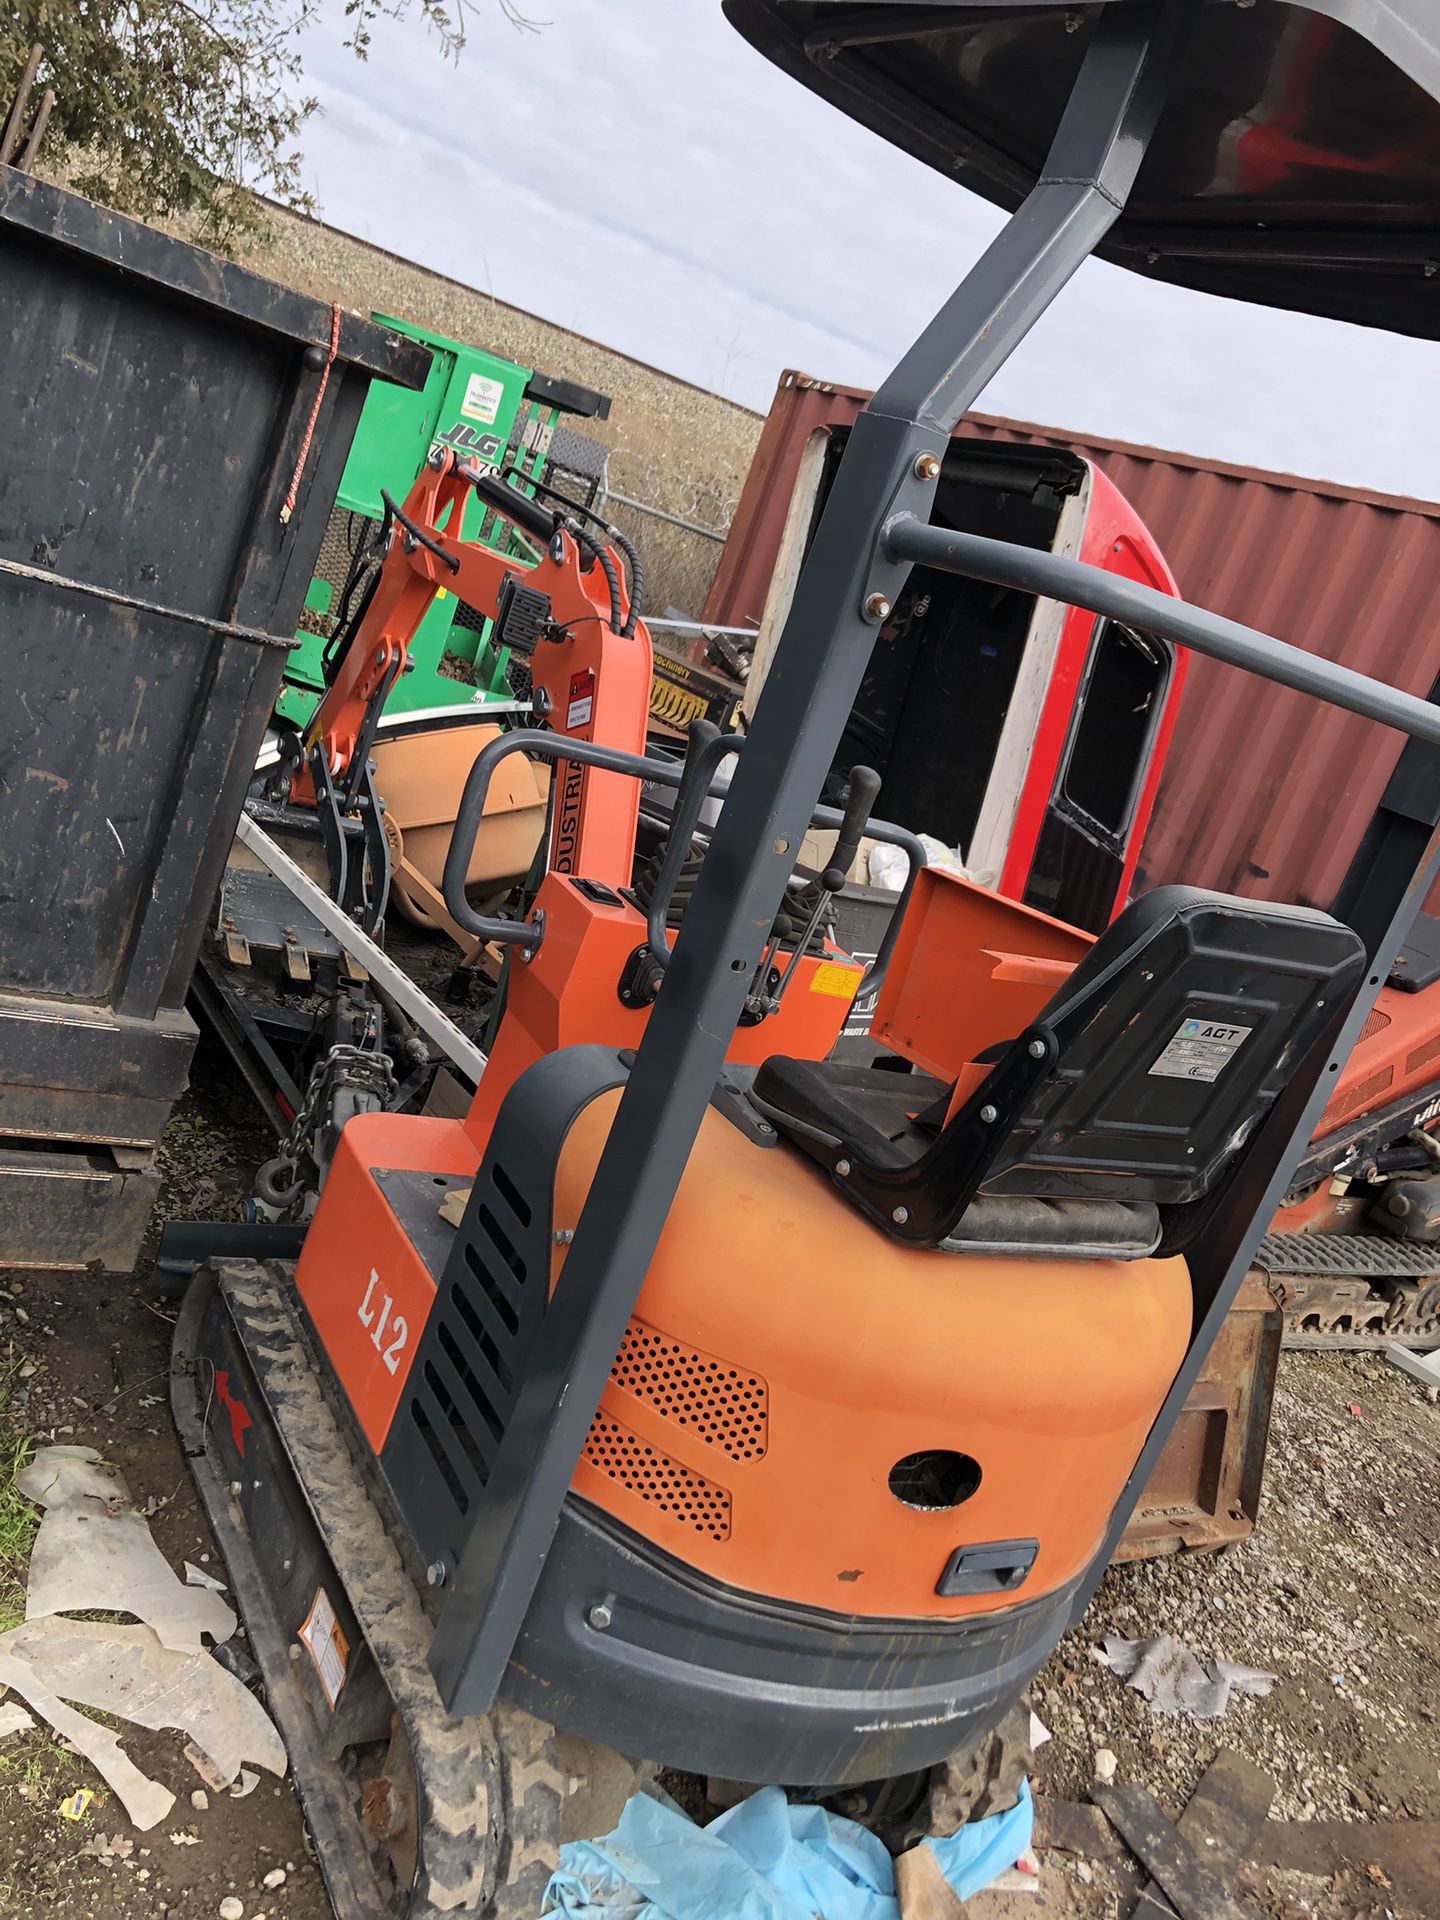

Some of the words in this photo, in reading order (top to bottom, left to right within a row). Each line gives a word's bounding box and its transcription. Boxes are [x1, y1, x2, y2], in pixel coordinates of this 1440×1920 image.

[438, 423, 504, 458] JLG
[1200, 1026, 1240, 1041] AGT
[357, 1267, 408, 1376] L12
